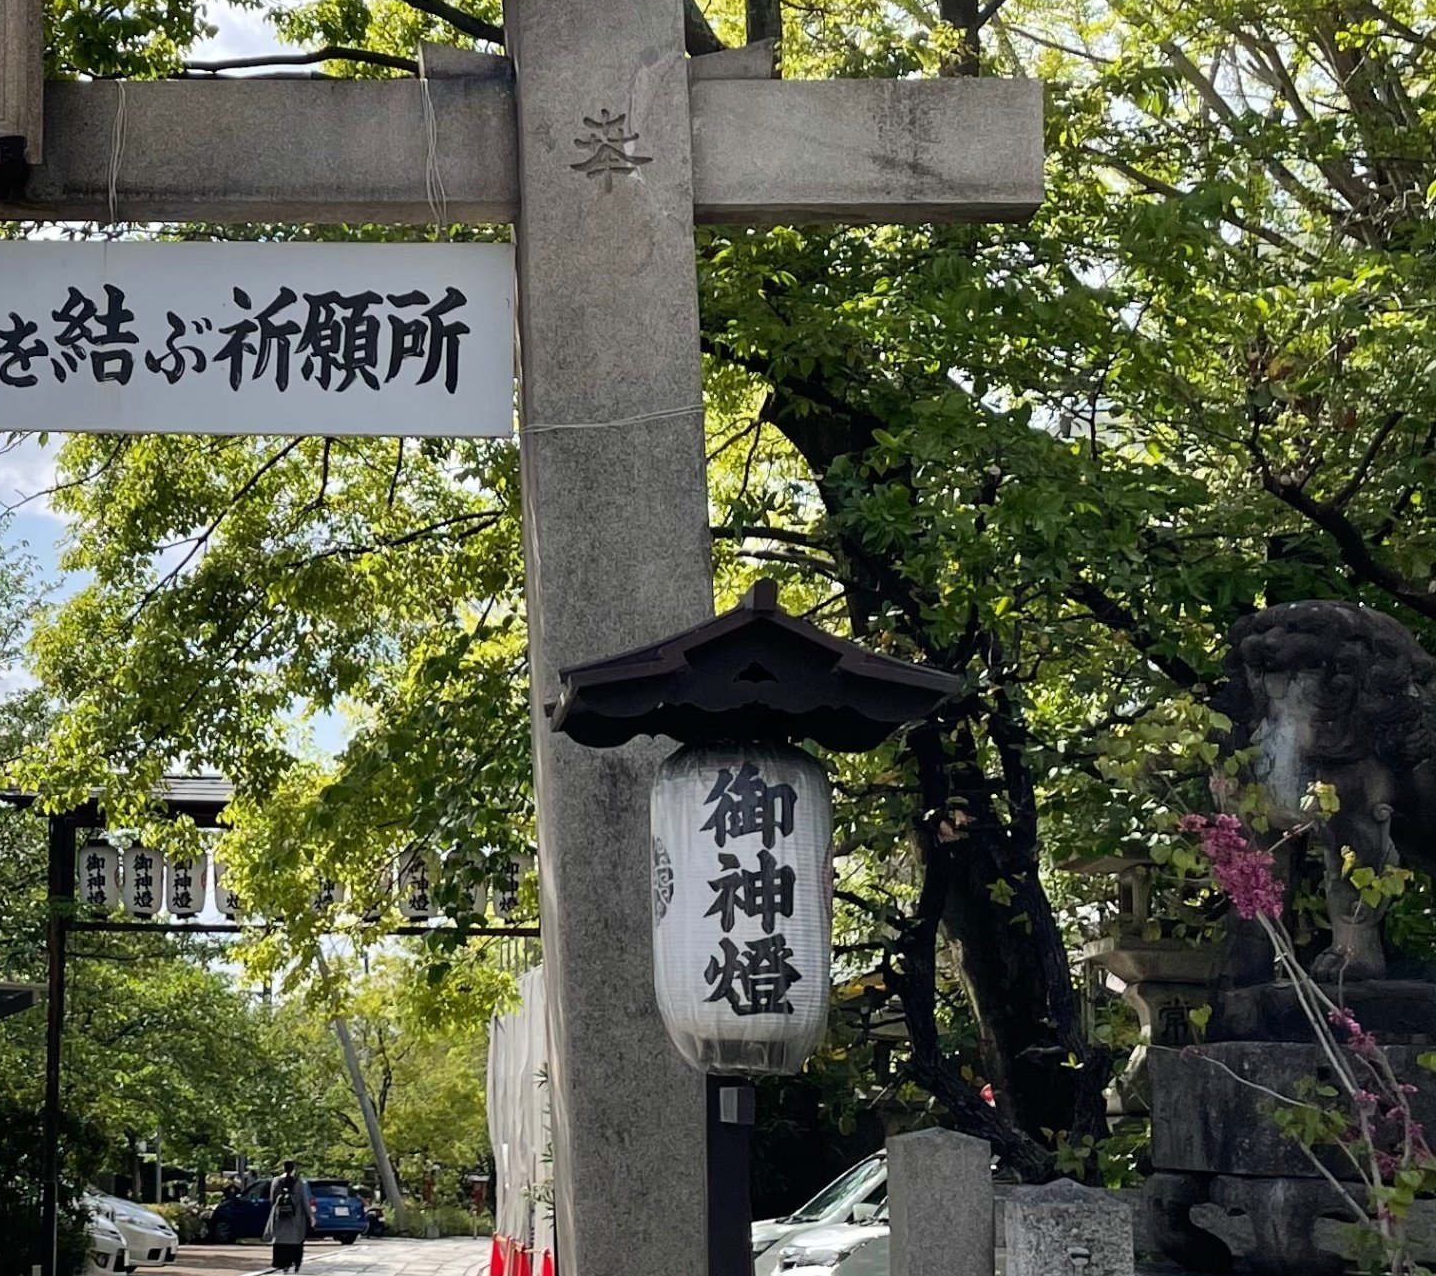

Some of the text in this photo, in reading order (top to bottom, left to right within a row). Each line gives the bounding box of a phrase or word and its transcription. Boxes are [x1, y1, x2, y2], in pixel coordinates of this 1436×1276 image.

[132, 853, 155, 909] 御神燈
[699, 761, 803, 1017] 御神燈
